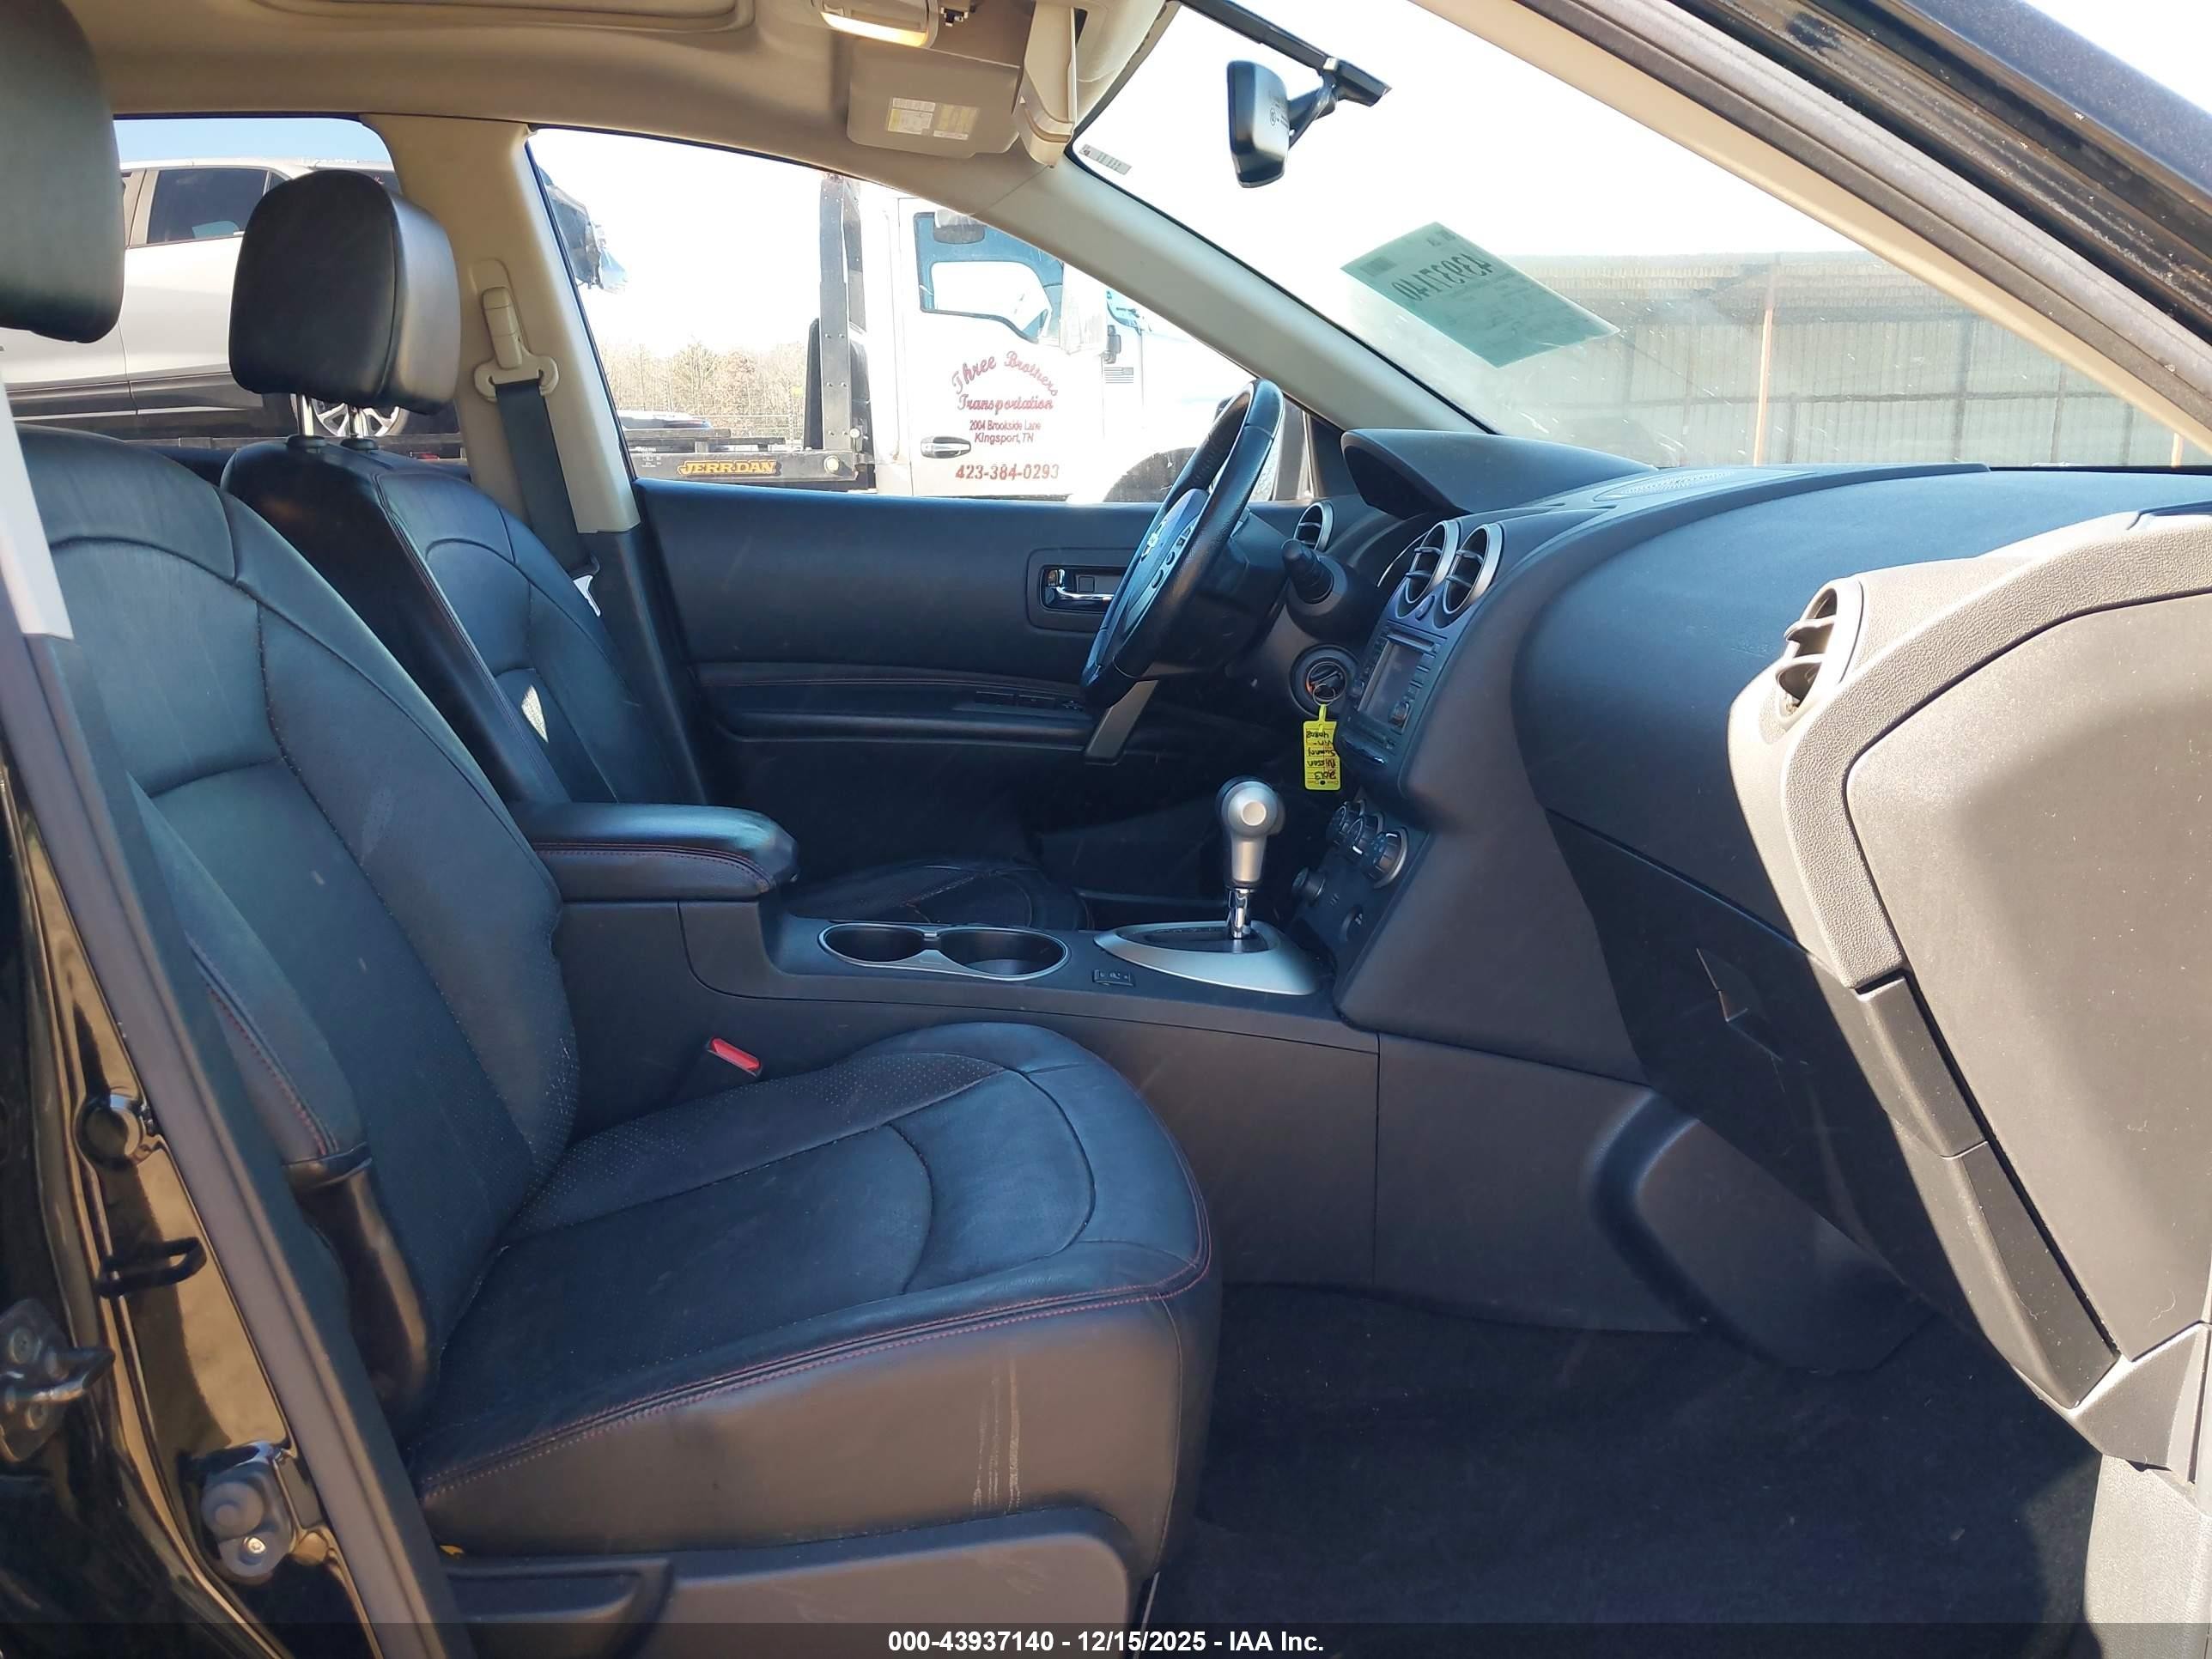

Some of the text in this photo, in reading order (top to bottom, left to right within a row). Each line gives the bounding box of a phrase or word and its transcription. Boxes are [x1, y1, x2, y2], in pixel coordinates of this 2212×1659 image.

[951, 350, 1059, 396] Three Brothers
[957, 393, 1054, 416] Transportation
[969, 419, 1041, 430] 2004 Brookside Lane
[975, 432, 1034, 445] Kingsport, TN
[955, 463, 1060, 481] 423-384-0293
